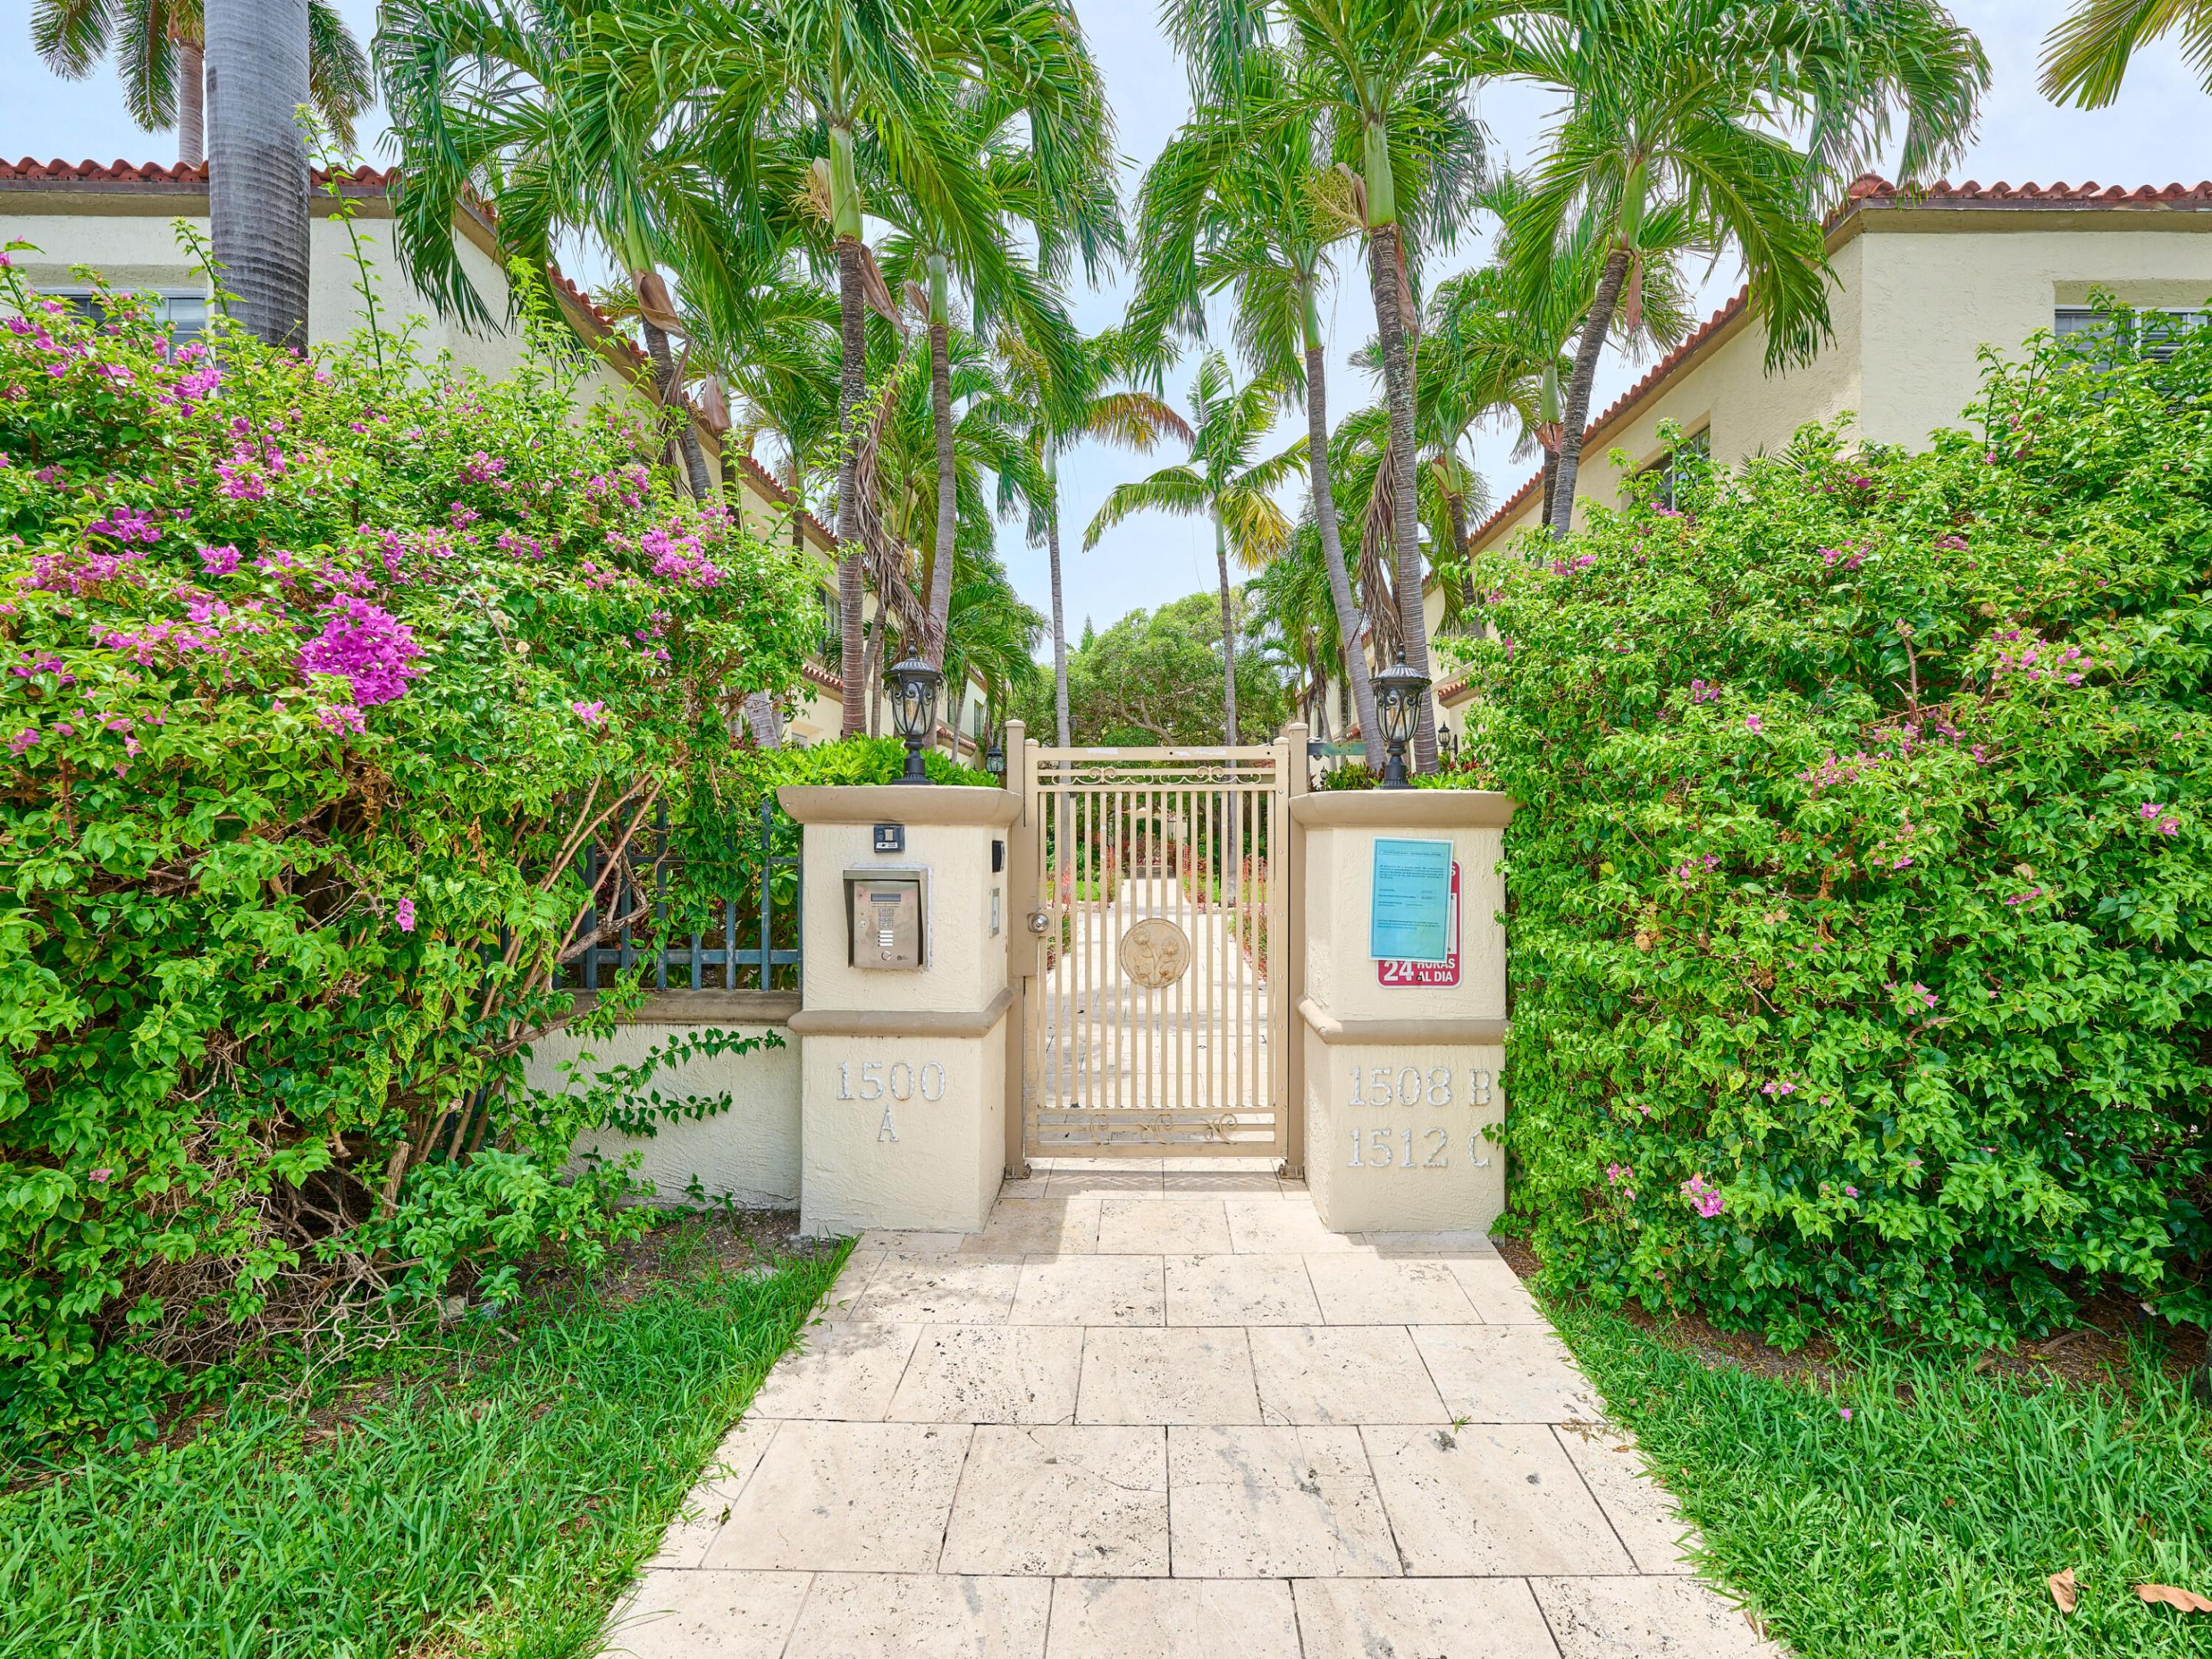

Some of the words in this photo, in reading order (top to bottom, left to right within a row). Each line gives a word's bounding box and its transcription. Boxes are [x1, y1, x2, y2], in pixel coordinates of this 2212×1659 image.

[1383, 959, 1415, 982] 24
[1417, 971, 1431, 982] AL
[1434, 971, 1453, 982] DIA
[836, 1060, 945, 1101] 1500
[1347, 1066, 1452, 1107] 1508
[1469, 1068, 1492, 1107] B
[877, 1104, 900, 1142] A
[1347, 1127, 1449, 1168] 1512
[1468, 1129, 1492, 1167] C
